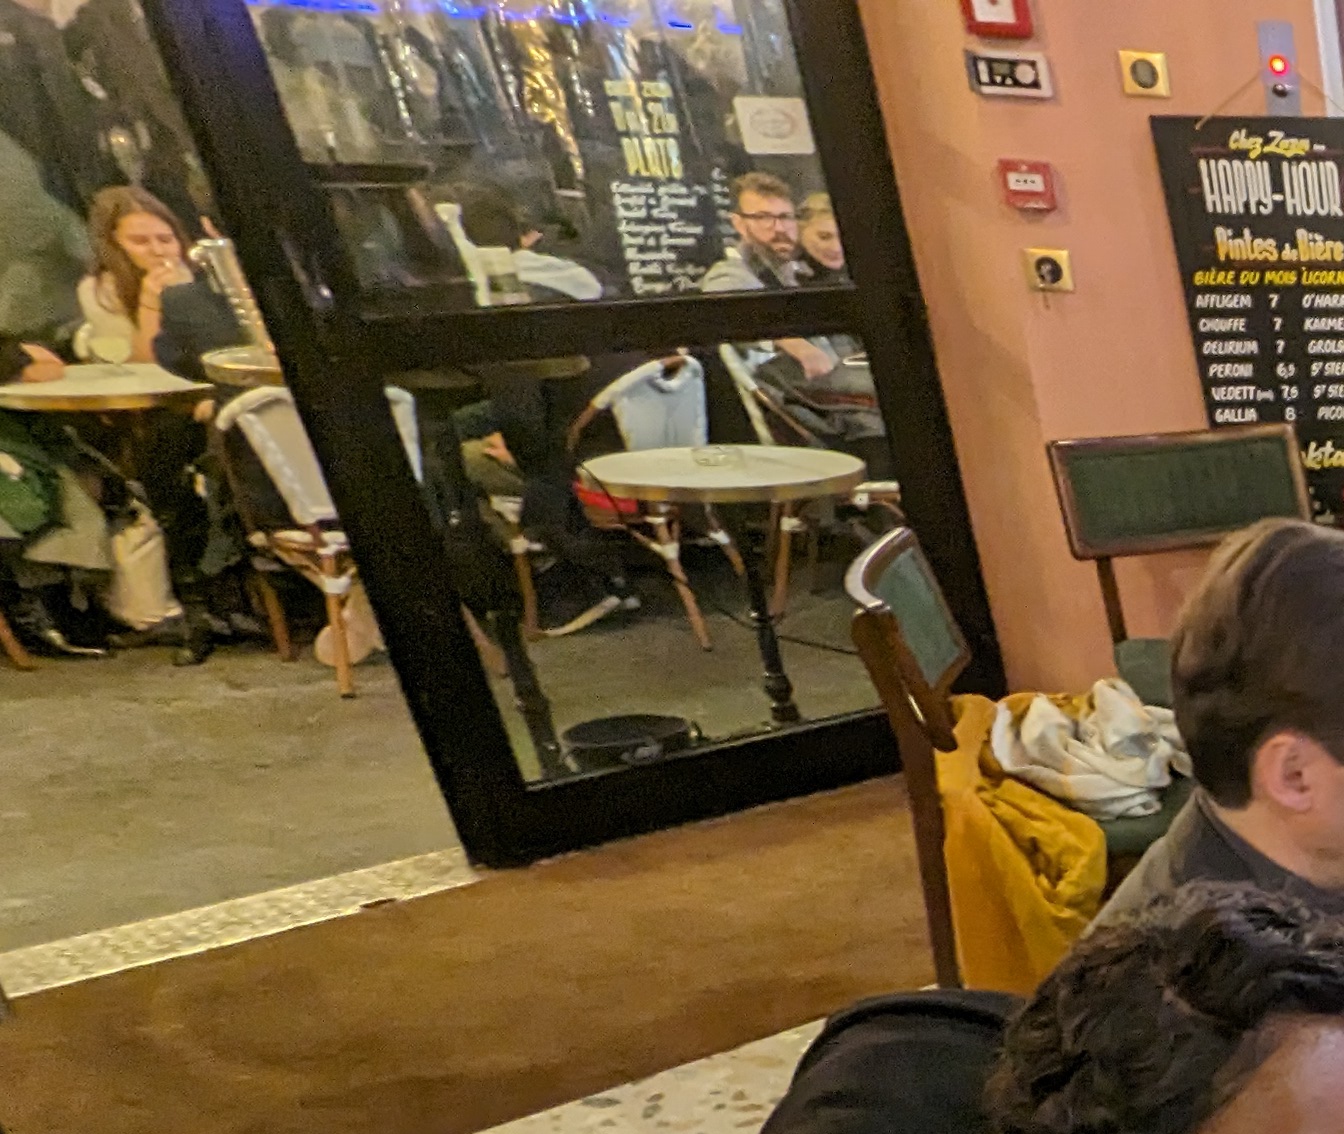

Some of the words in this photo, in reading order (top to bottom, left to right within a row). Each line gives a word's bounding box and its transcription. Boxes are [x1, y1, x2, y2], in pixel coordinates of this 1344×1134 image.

[1229, 128, 1263, 159] Chez
[1199, 158, 1344, 218] HAPPY-HOUR
[1214, 225, 1280, 262] Pintes
[1239, 269, 1261, 287] DU
[1268, 294, 1280, 309] 7
[1273, 316, 1284, 332] 7
[1275, 338, 1286, 354] 7
[1210, 385, 1256, 401] VEDETT
[1284, 405, 1297, 421] 8
